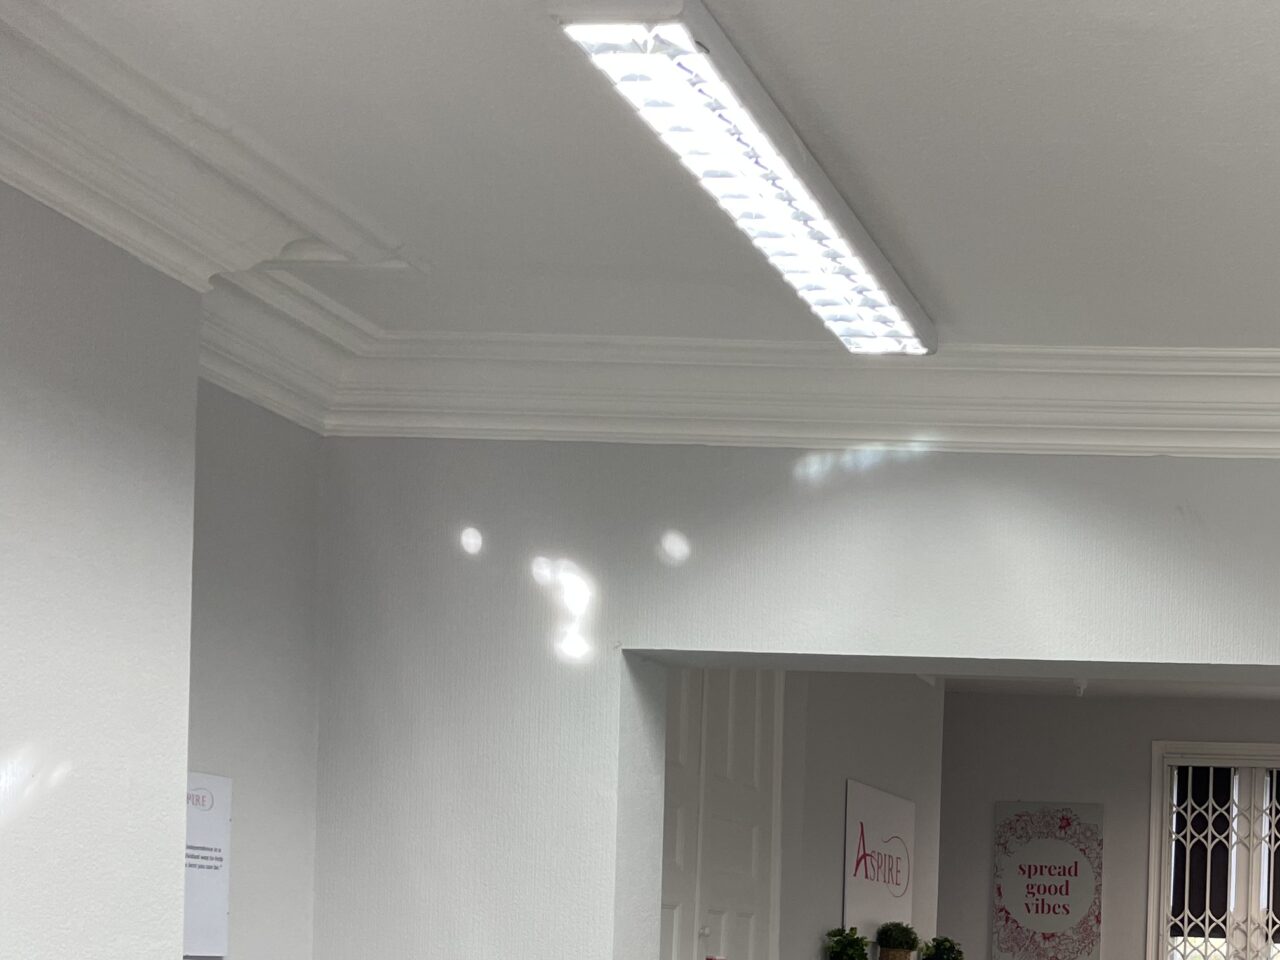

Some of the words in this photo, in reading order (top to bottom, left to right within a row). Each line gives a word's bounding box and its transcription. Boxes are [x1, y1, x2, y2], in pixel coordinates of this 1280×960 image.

[186, 792, 207, 808] PIRE
[1017, 860, 1080, 880] spread
[1025, 879, 1070, 898] good
[1025, 898, 1071, 916] vibes
